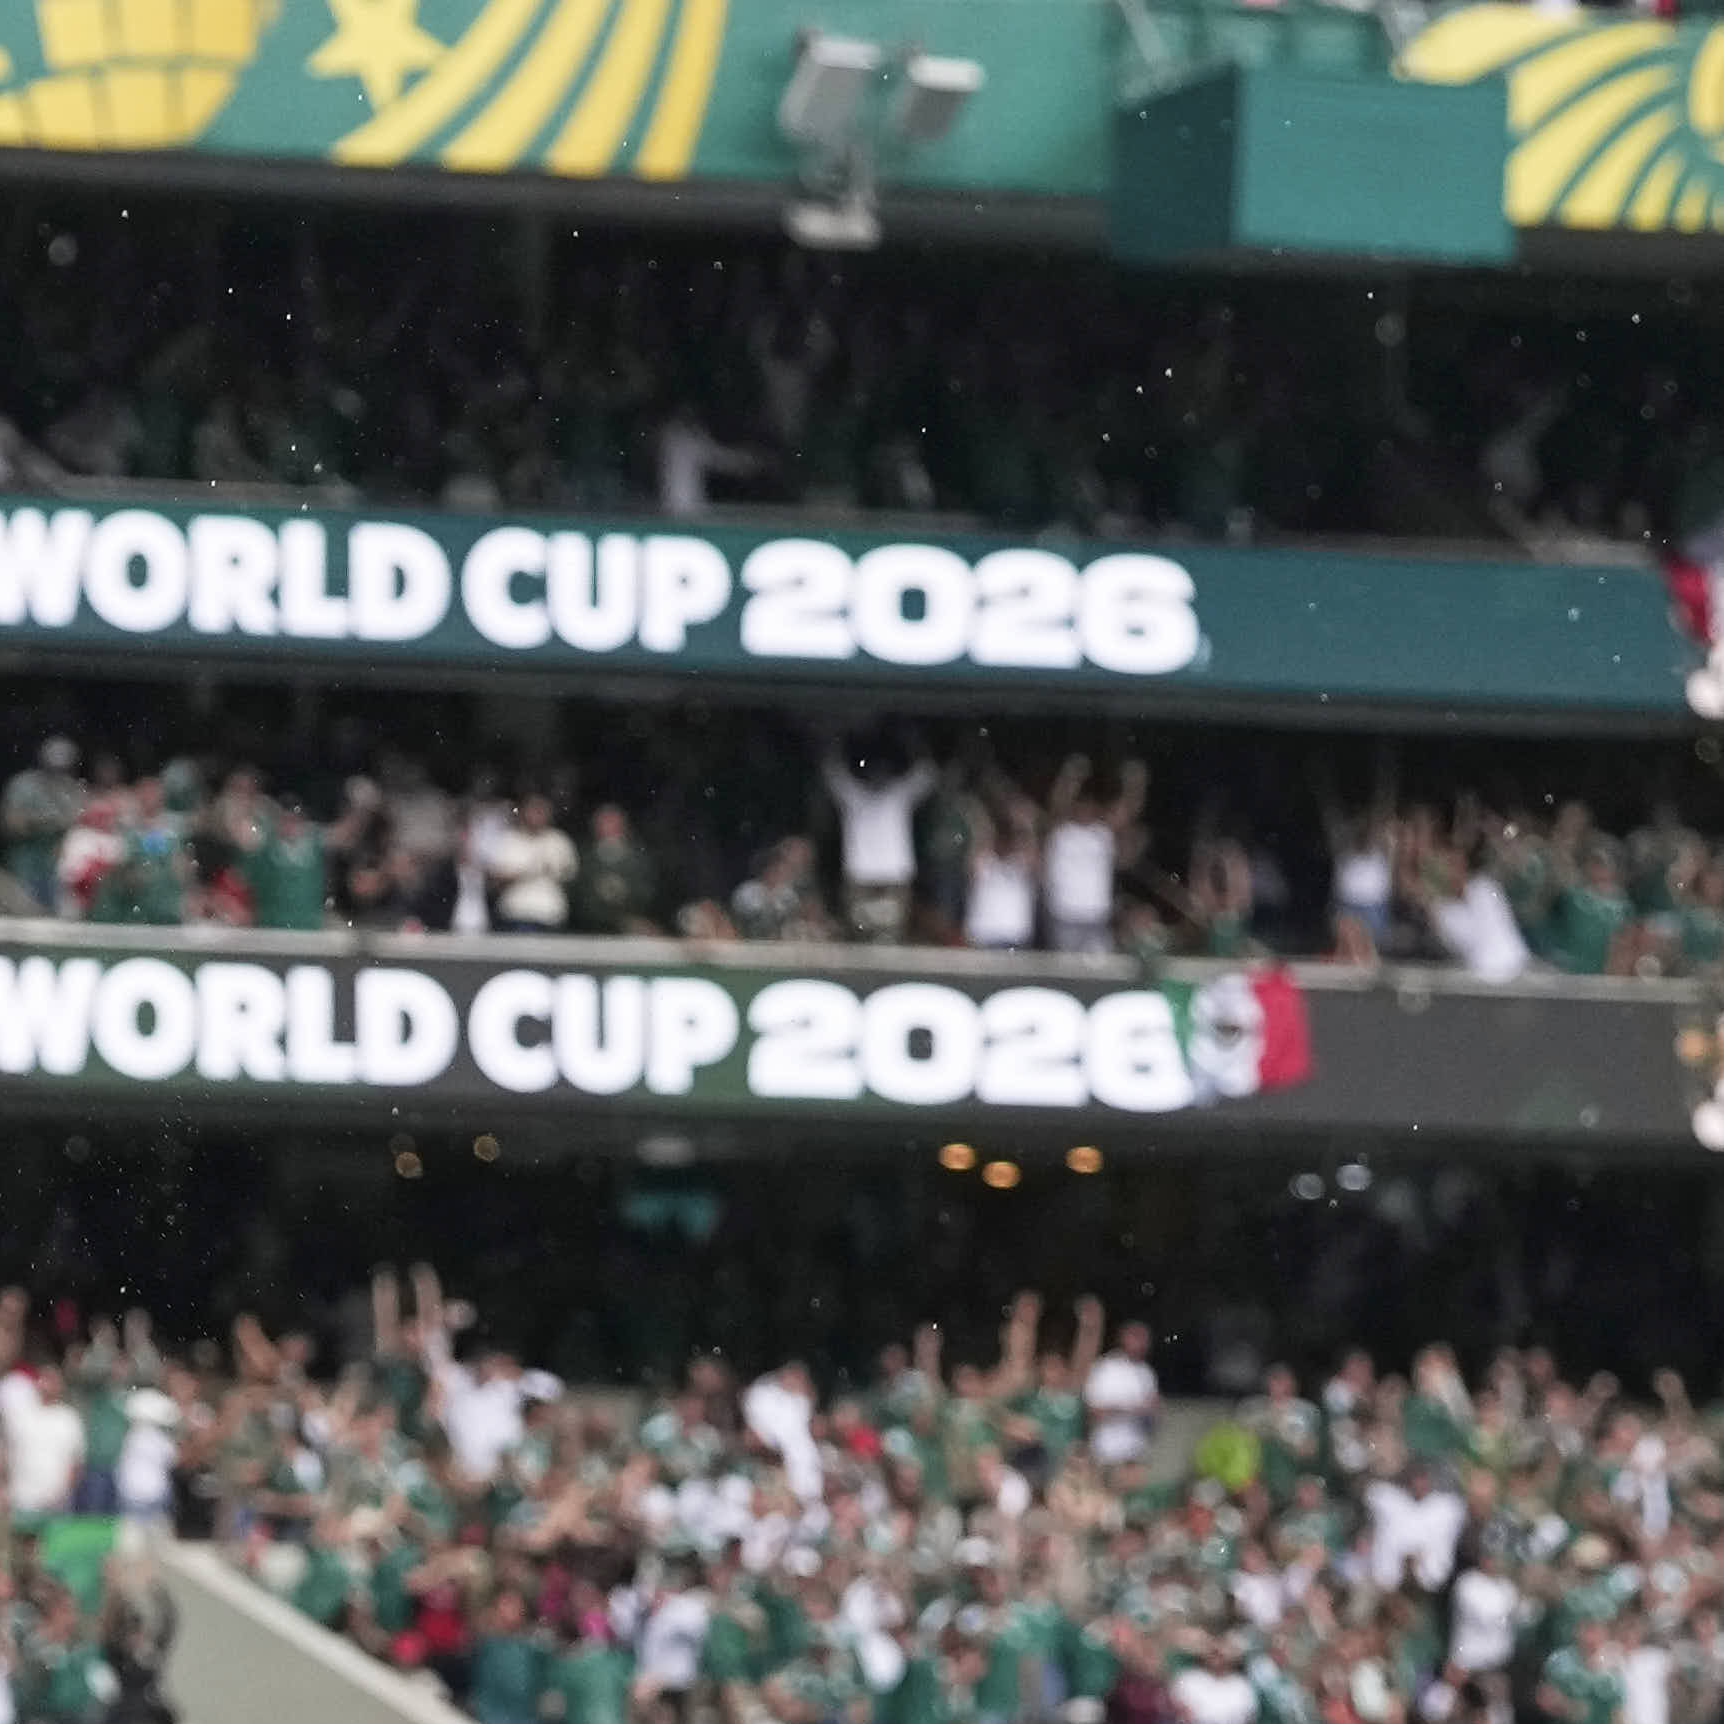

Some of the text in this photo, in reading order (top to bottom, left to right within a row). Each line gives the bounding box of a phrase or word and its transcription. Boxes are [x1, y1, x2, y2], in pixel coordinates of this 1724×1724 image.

[461, 526, 733, 653] CUP
[739, 537, 1201, 674] 2026
[467, 969, 739, 1096] CUP
[747, 979, 1196, 1113] 2026
